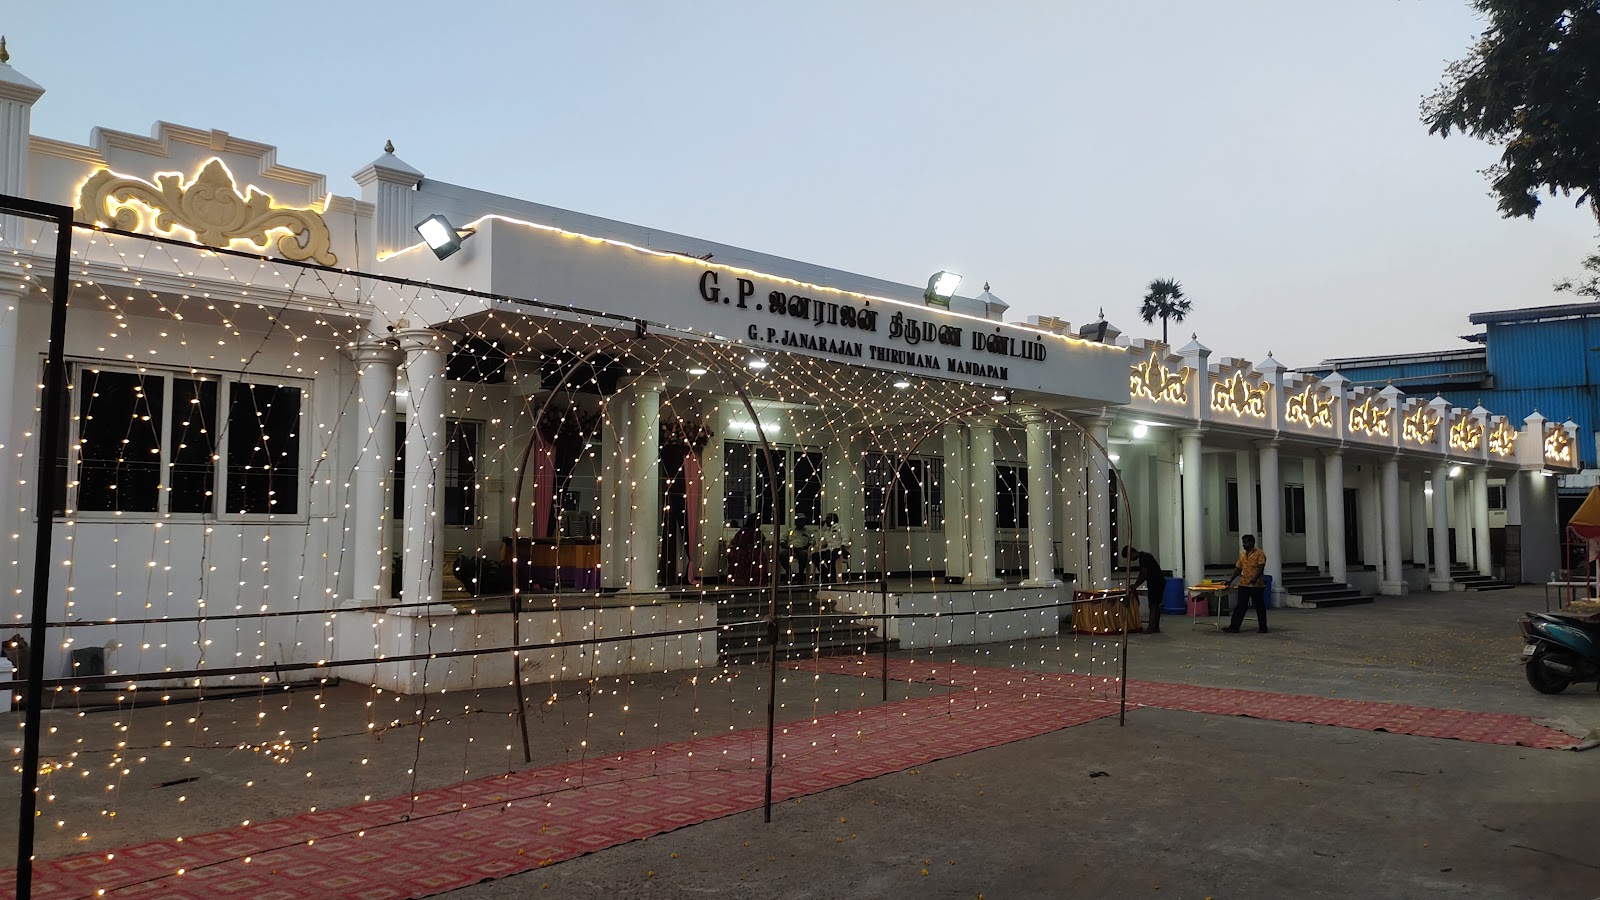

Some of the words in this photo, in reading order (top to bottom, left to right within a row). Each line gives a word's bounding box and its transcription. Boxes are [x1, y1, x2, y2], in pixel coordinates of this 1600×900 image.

[889, 311, 963, 347] திருமண
[972, 327, 1047, 362] மண்டபம்
[869, 345, 941, 370] THIRUMANA
[947, 358, 1009, 381] MANDAPAM
